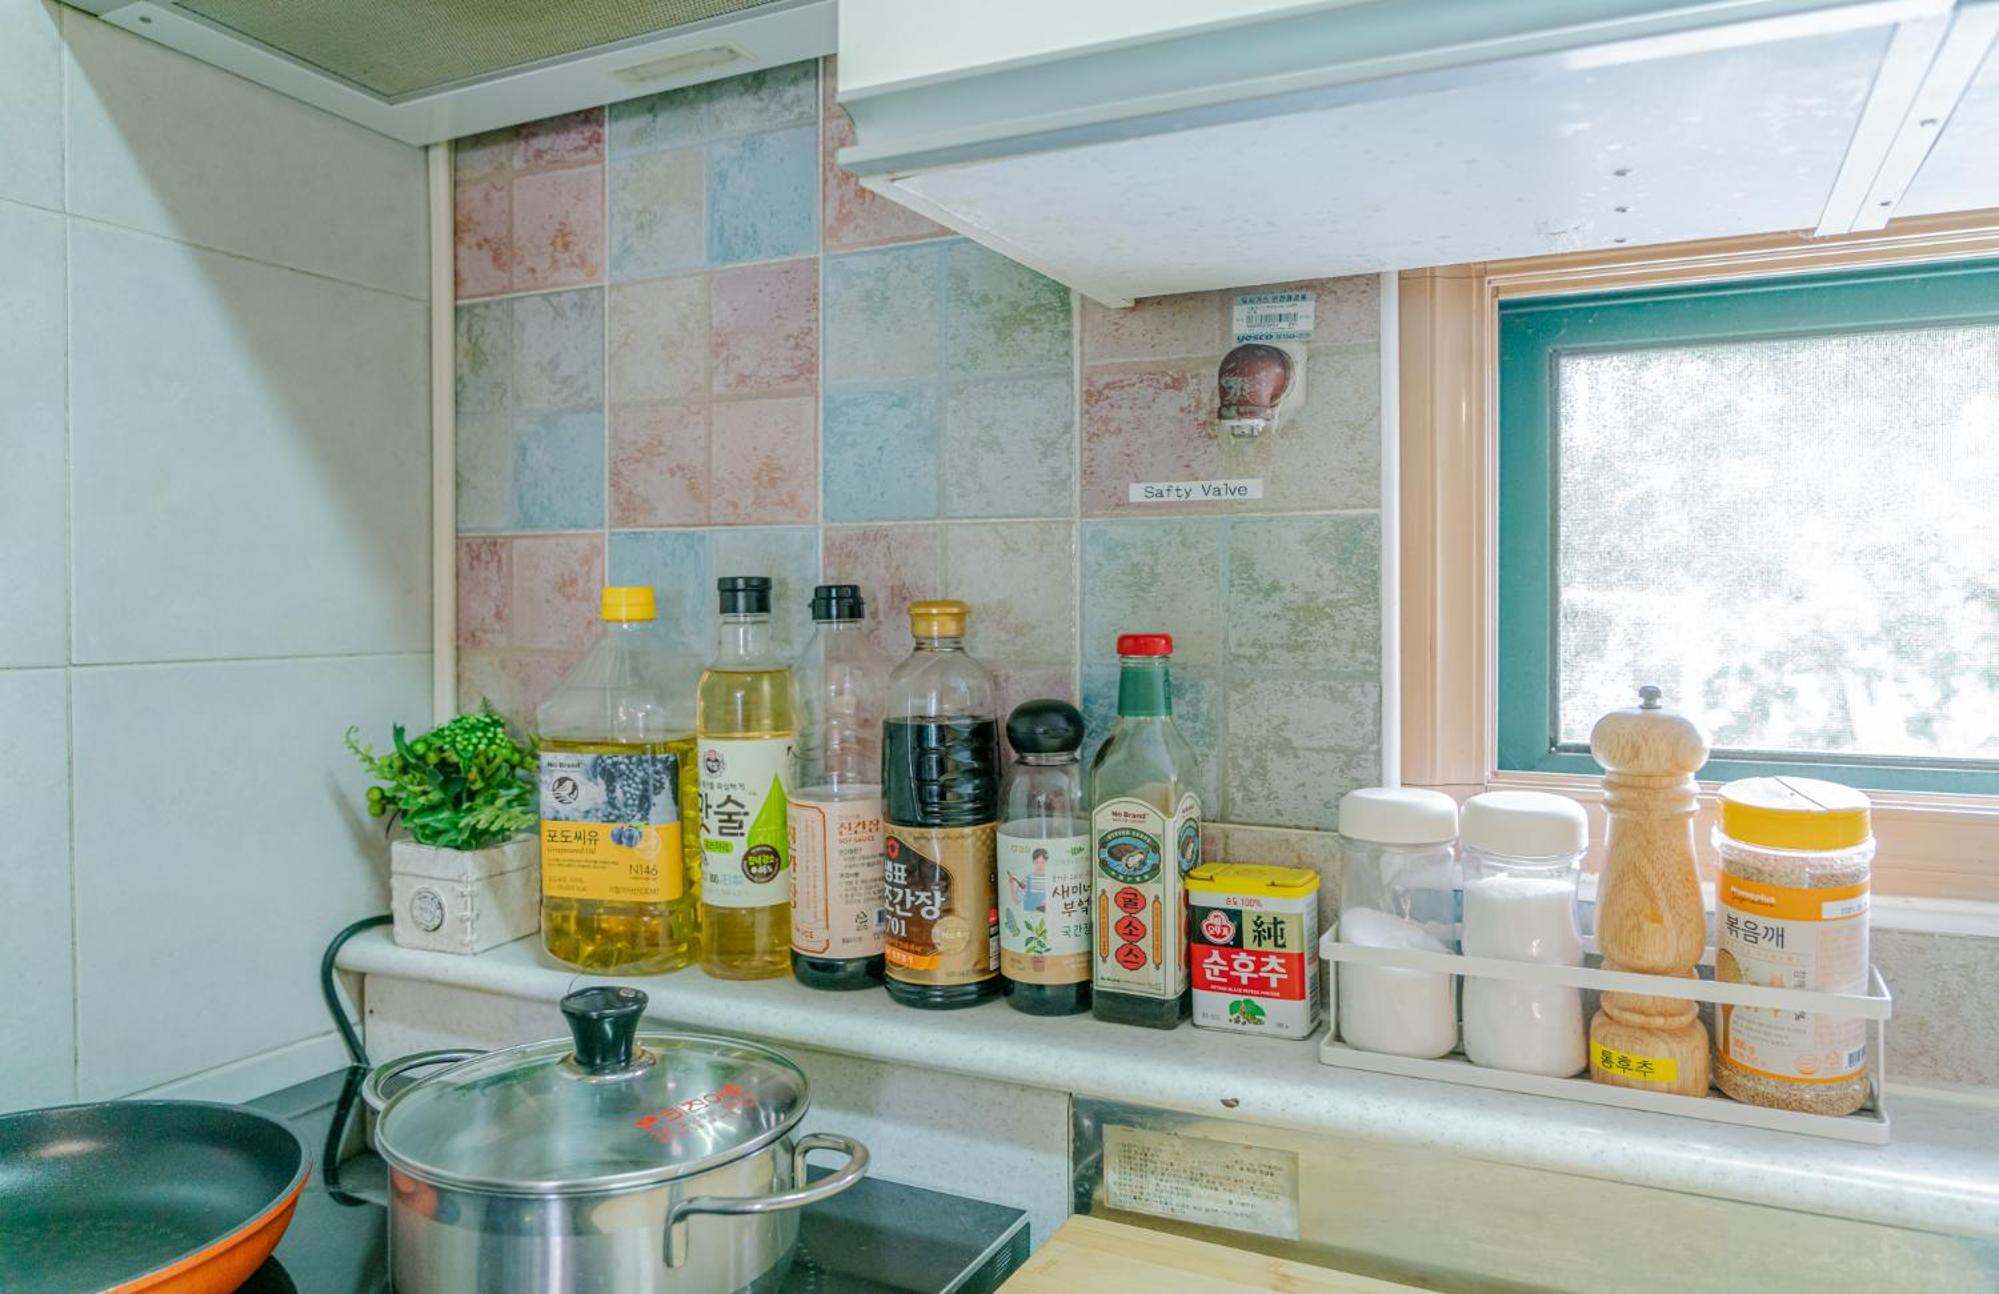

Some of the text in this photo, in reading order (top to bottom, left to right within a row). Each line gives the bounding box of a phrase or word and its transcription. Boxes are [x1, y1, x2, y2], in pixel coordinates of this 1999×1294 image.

[1143, 482, 1248, 500] Safty Valve
[547, 829, 600, 846] 포도씨유
[629, 864, 659, 877] N146
[1251, 914, 1287, 949] 純
[1726, 912, 1785, 950] 볶음깨
[1202, 949, 1289, 989] 순후추
[1600, 1048, 1656, 1078] 통후추
